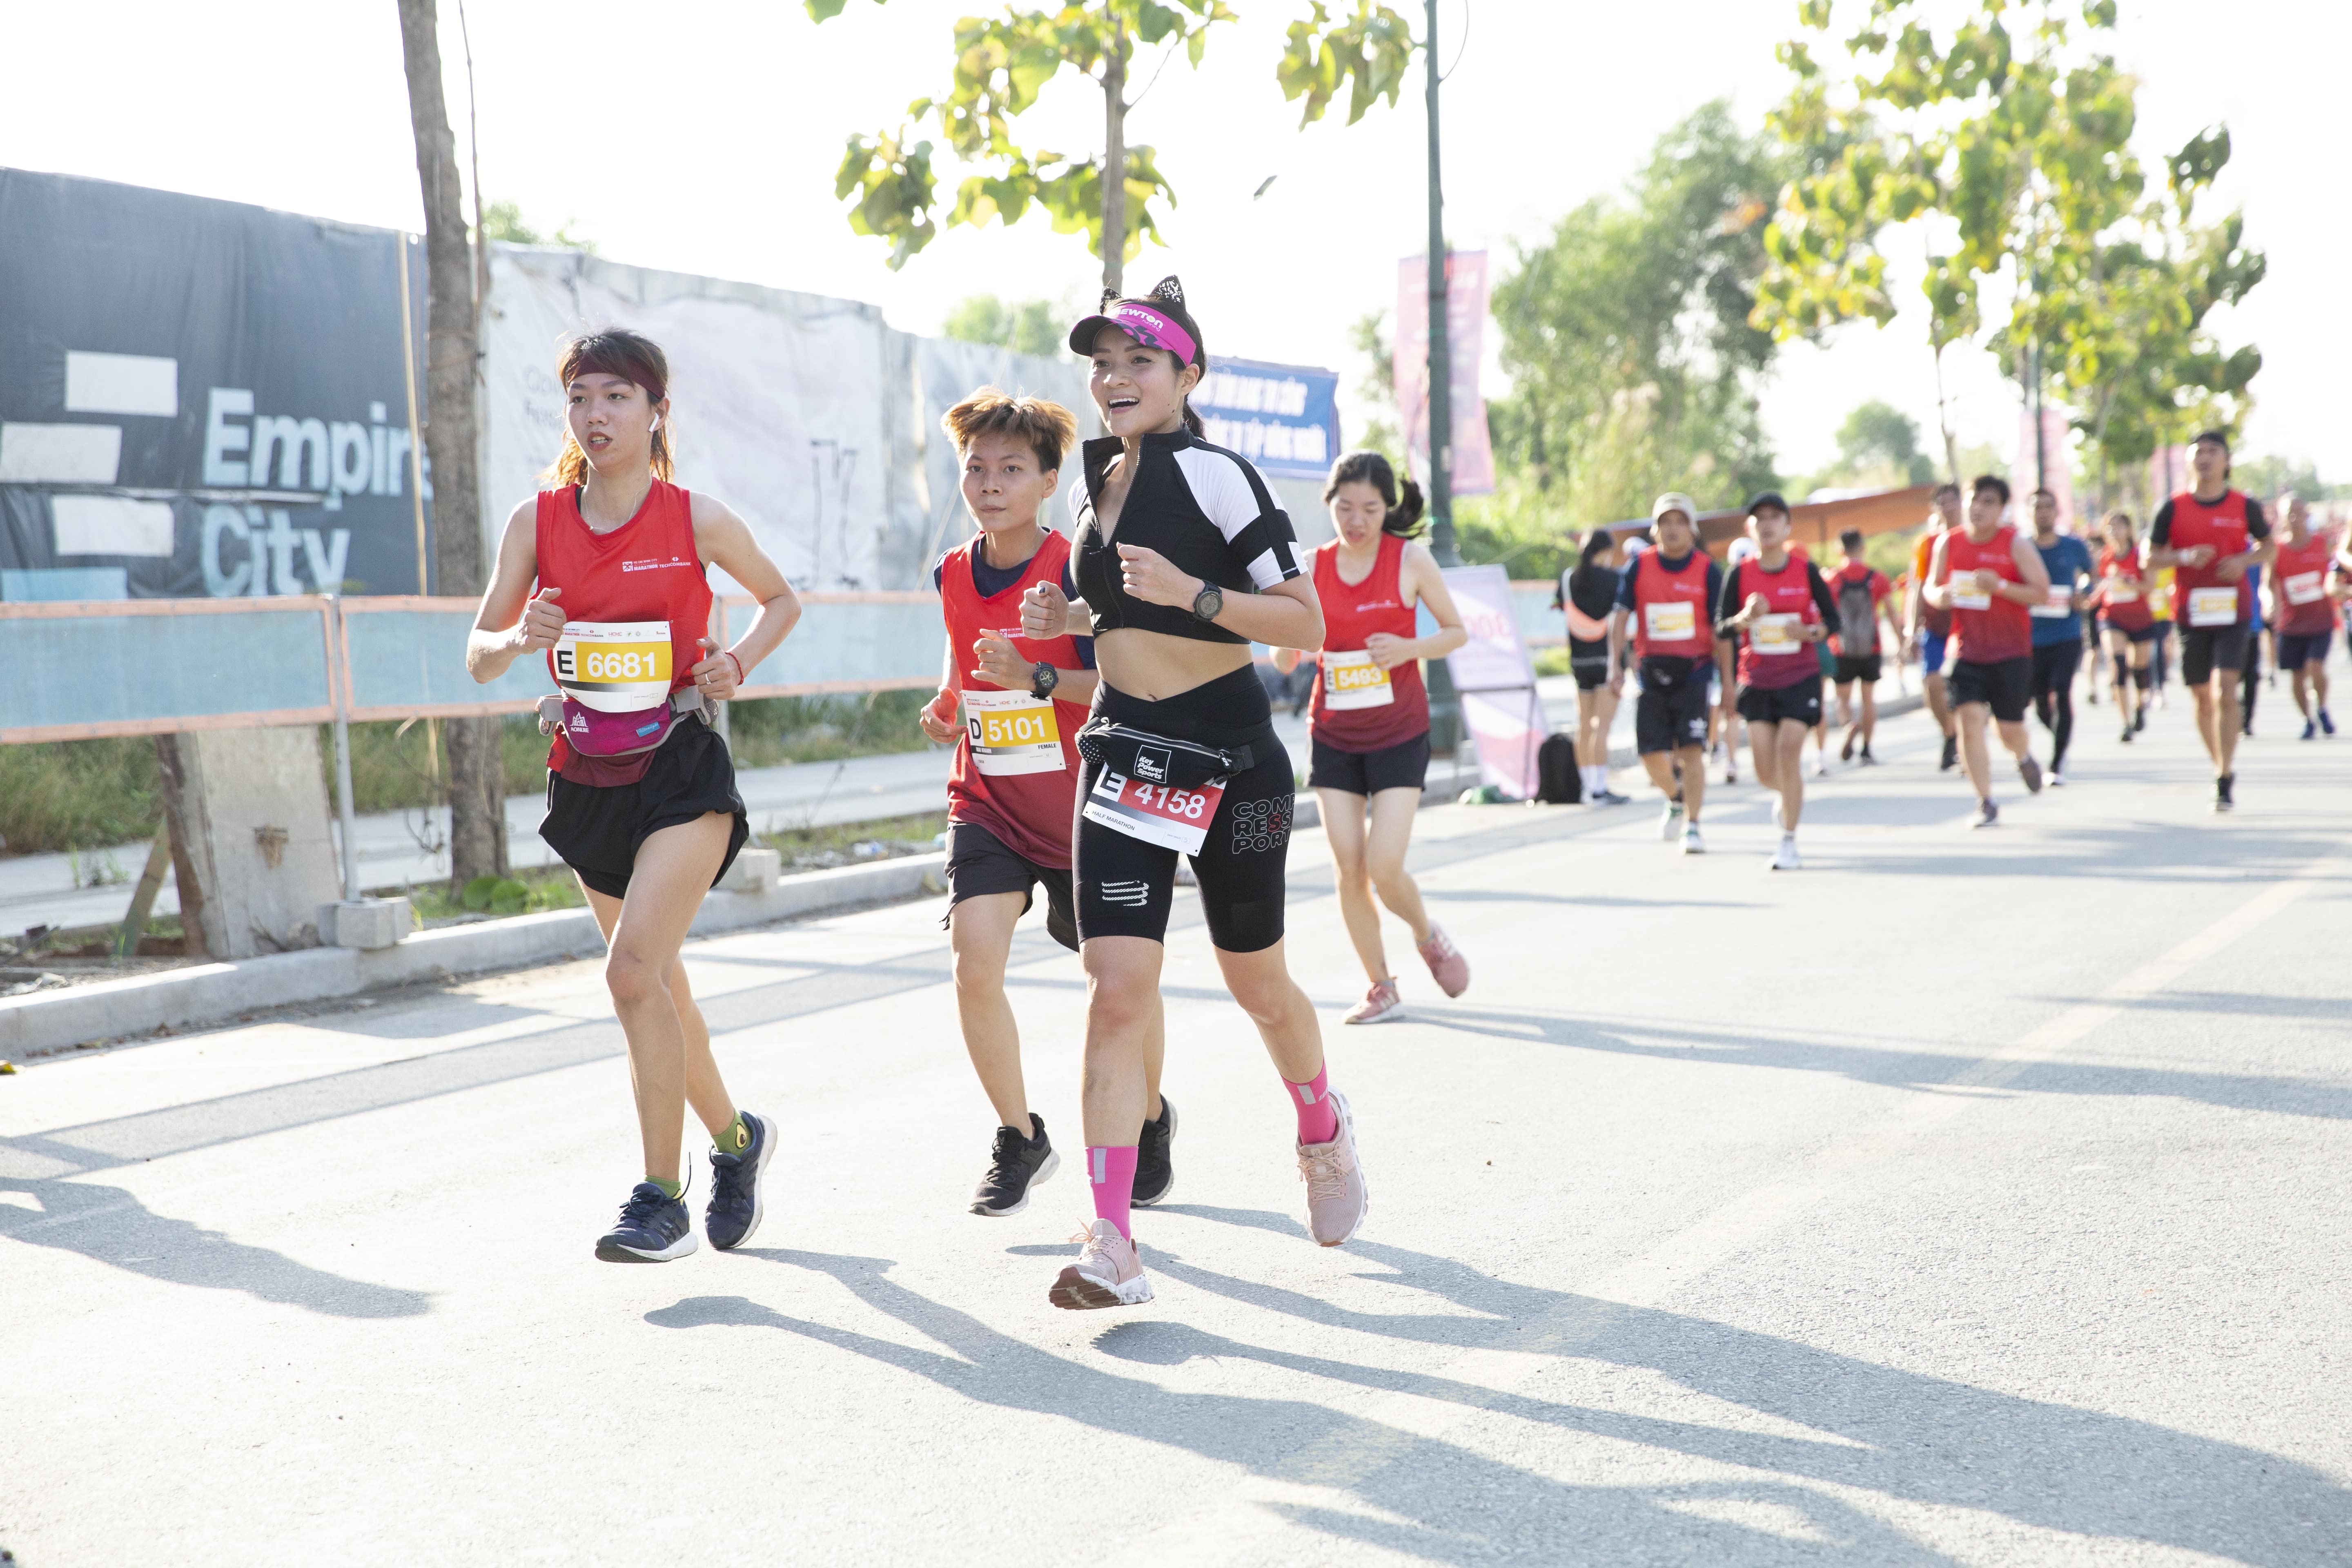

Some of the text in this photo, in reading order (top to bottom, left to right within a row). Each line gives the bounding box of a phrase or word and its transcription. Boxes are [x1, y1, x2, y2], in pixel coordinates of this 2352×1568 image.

[1143, 319, 1160, 332] running
[200, 503, 350, 597] City
[557, 650, 655, 678] E 6681
[1338, 666, 1382, 687] 5493
[969, 715, 1045, 742] D 5101
[1137, 762, 1164, 773] Power
[1139, 756, 1154, 766] Key
[1100, 765, 1205, 819] E 4158
[1233, 792, 1295, 819] COMP
[1092, 810, 1135, 831] HALF MARATHON
[1233, 811, 1291, 837] RESS
[1232, 826, 1291, 854] PORT
